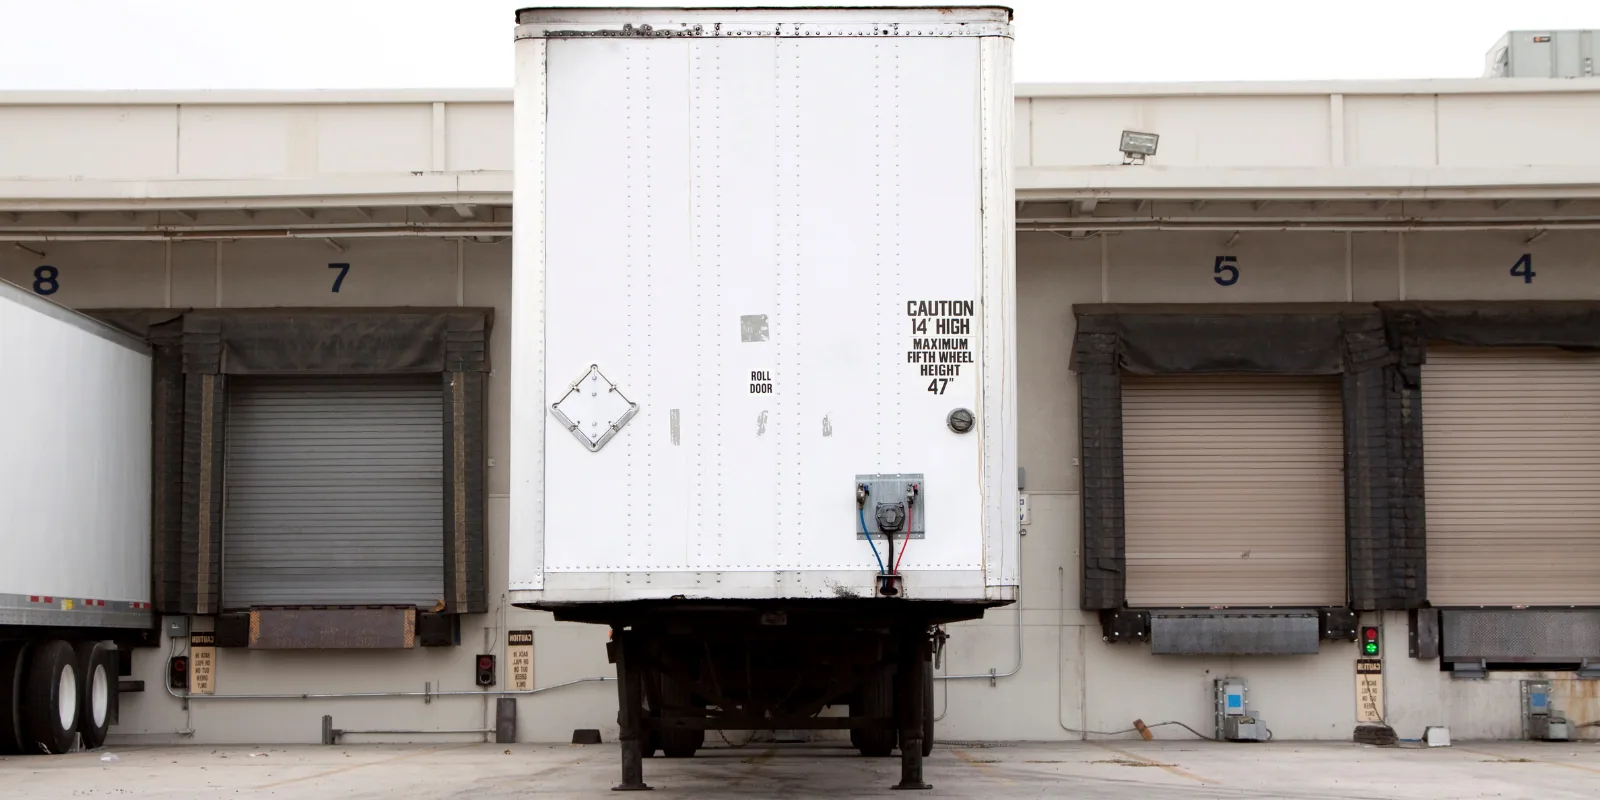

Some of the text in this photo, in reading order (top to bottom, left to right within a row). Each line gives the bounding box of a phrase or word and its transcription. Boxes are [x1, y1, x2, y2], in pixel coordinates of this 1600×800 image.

[1213, 255, 1240, 286] 5
[1509, 253, 1536, 284] 4
[32, 265, 59, 296] 8
[327, 262, 351, 293] 7
[907, 300, 974, 316] CAUTION
[911, 318, 970, 335] 14' HIGH
[913, 338, 968, 350] MAXIMUM
[907, 351, 974, 363] FIFTH WHEEL
[751, 371, 772, 381] ROLL
[920, 364, 961, 376] HEIGHT
[749, 383, 773, 394] DOOR
[927, 377, 954, 395] 47"
